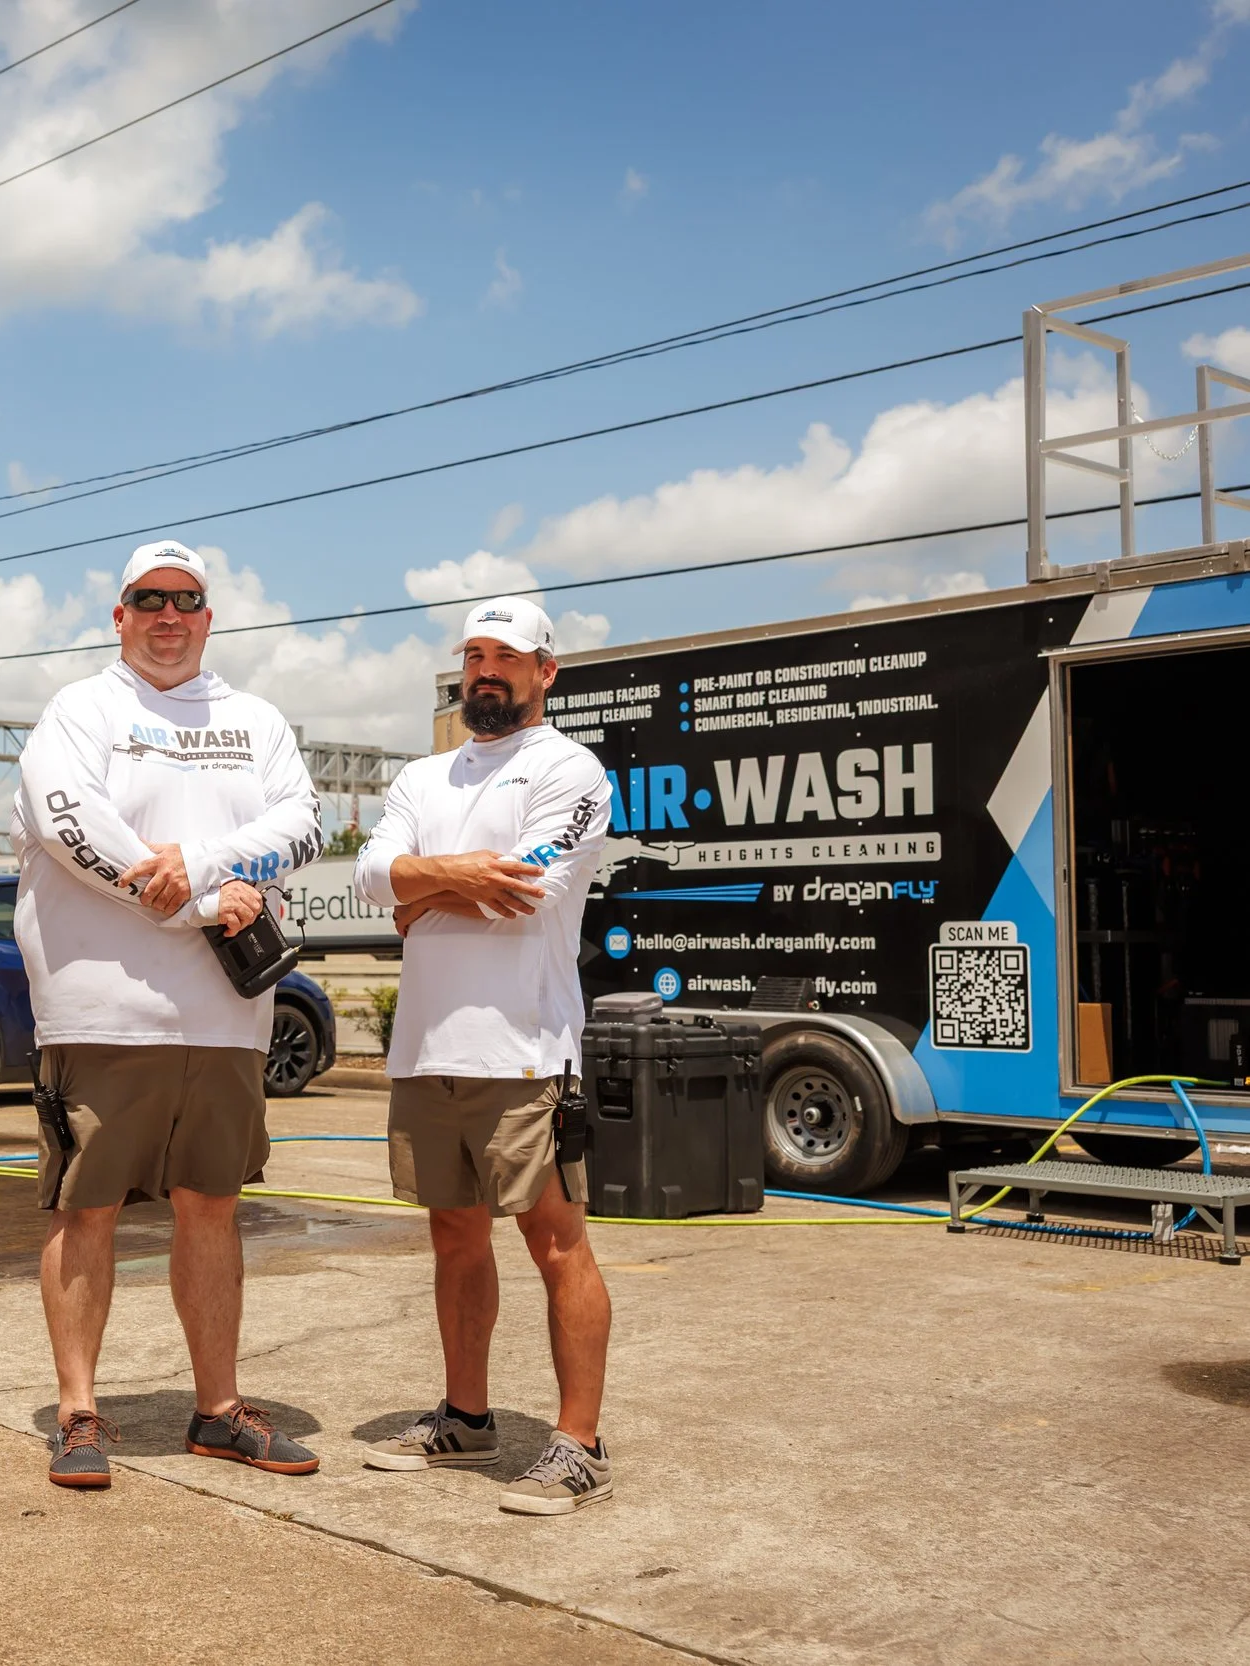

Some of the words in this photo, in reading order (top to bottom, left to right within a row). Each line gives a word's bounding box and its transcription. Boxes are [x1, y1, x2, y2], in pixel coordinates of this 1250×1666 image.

[693, 672, 754, 693] PRE-PAINT
[755, 670, 773, 685] OR
[774, 658, 866, 684] CONSTRUCTION
[869, 651, 927, 673] CLEANUP
[547, 697, 566, 711] FOR
[567, 690, 614, 709] BUILDING
[694, 694, 734, 713] SMART
[735, 691, 767, 709] ROOF
[768, 684, 828, 705] CLEANING
[555, 711, 601, 728] WINDOW
[602, 705, 653, 723] CLEANING
[694, 712, 774, 732] COMMERCIAL,
[776, 702, 856, 726] RESIDENTIAL,
[175, 729, 251, 750] WASH
[713, 742, 934, 826] WASH
[698, 846, 794, 863] HEIGHTS
[811, 840, 936, 858] CLEANING
[773, 884, 795, 902] BY
[636, 932, 876, 954] hello@airwash.draganfly.com
[948, 926, 984, 942] SCAN
[987, 926, 1010, 941] ME
